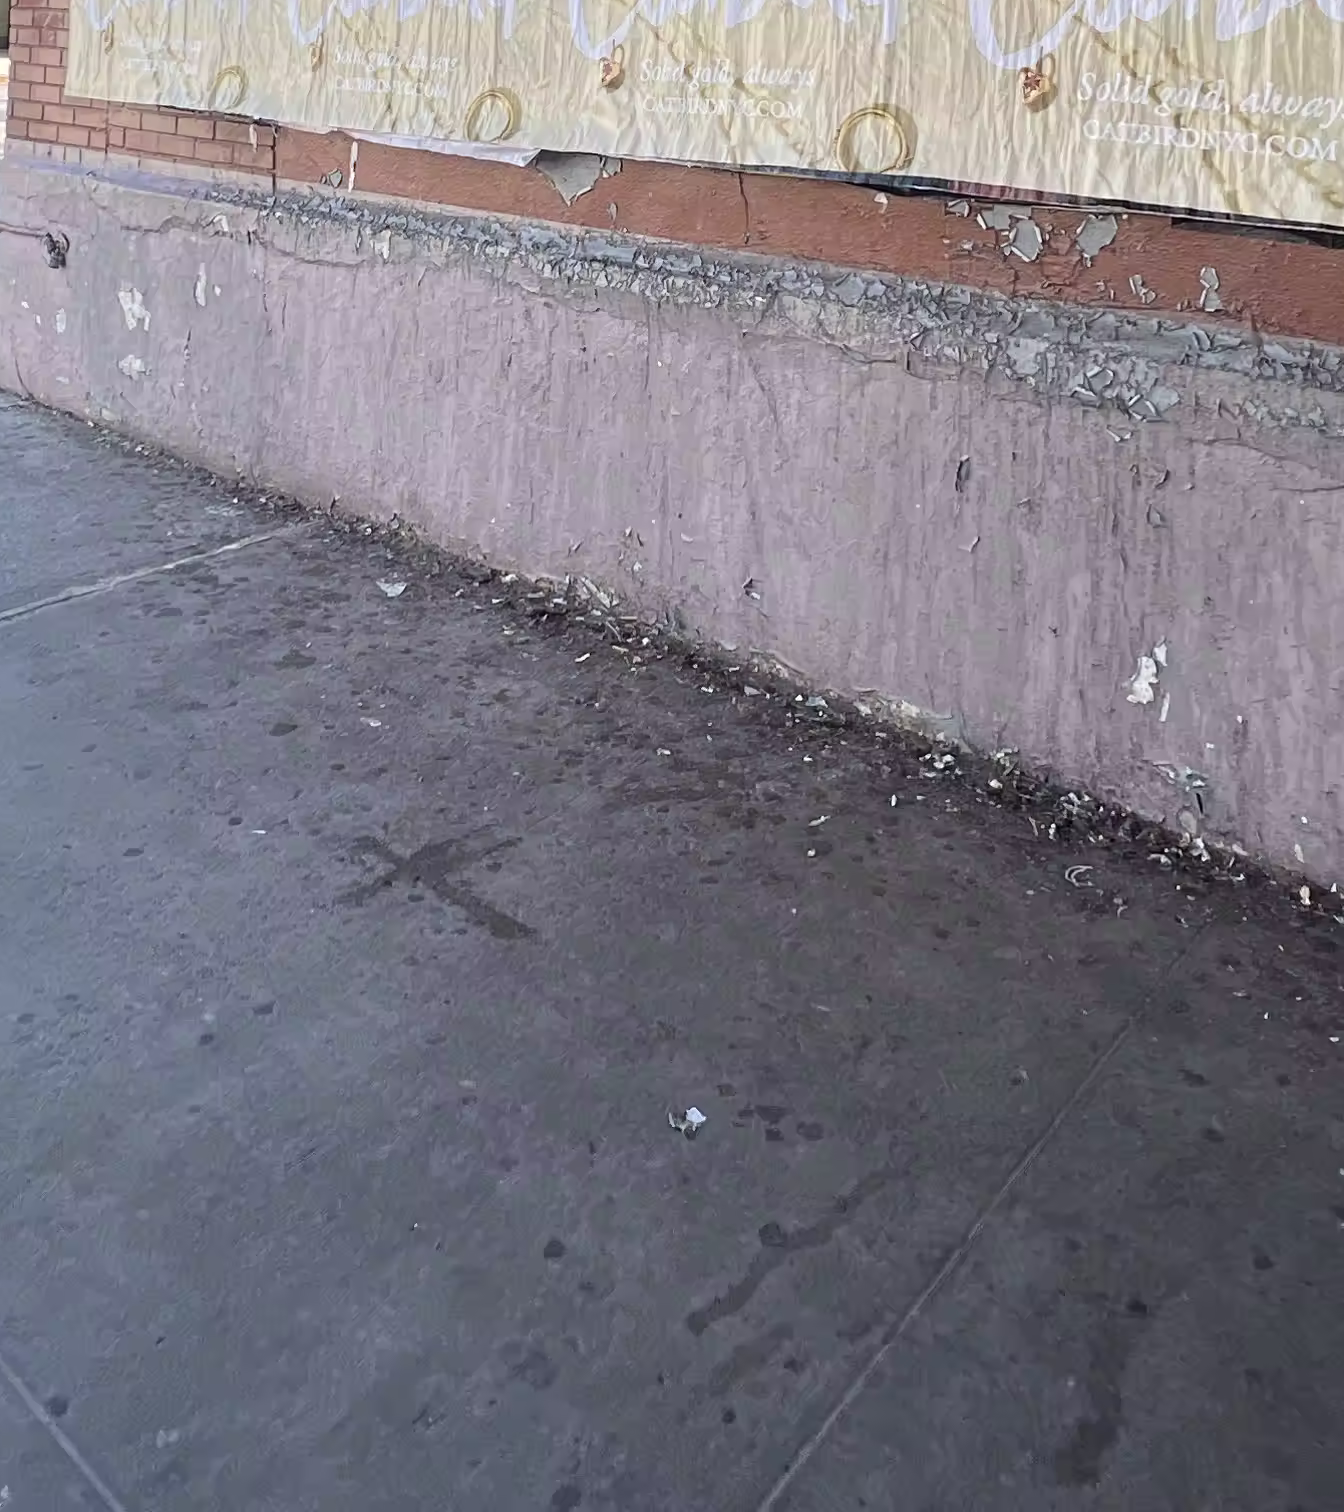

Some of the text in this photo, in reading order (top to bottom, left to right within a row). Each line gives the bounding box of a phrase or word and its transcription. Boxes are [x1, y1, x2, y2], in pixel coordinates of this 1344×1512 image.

[742, 59, 816, 93] always
[1076, 71, 1152, 105] Solid
[1154, 76, 1231, 117] gold,
[1082, 118, 1339, 162] CATBIRDNYC.COM
